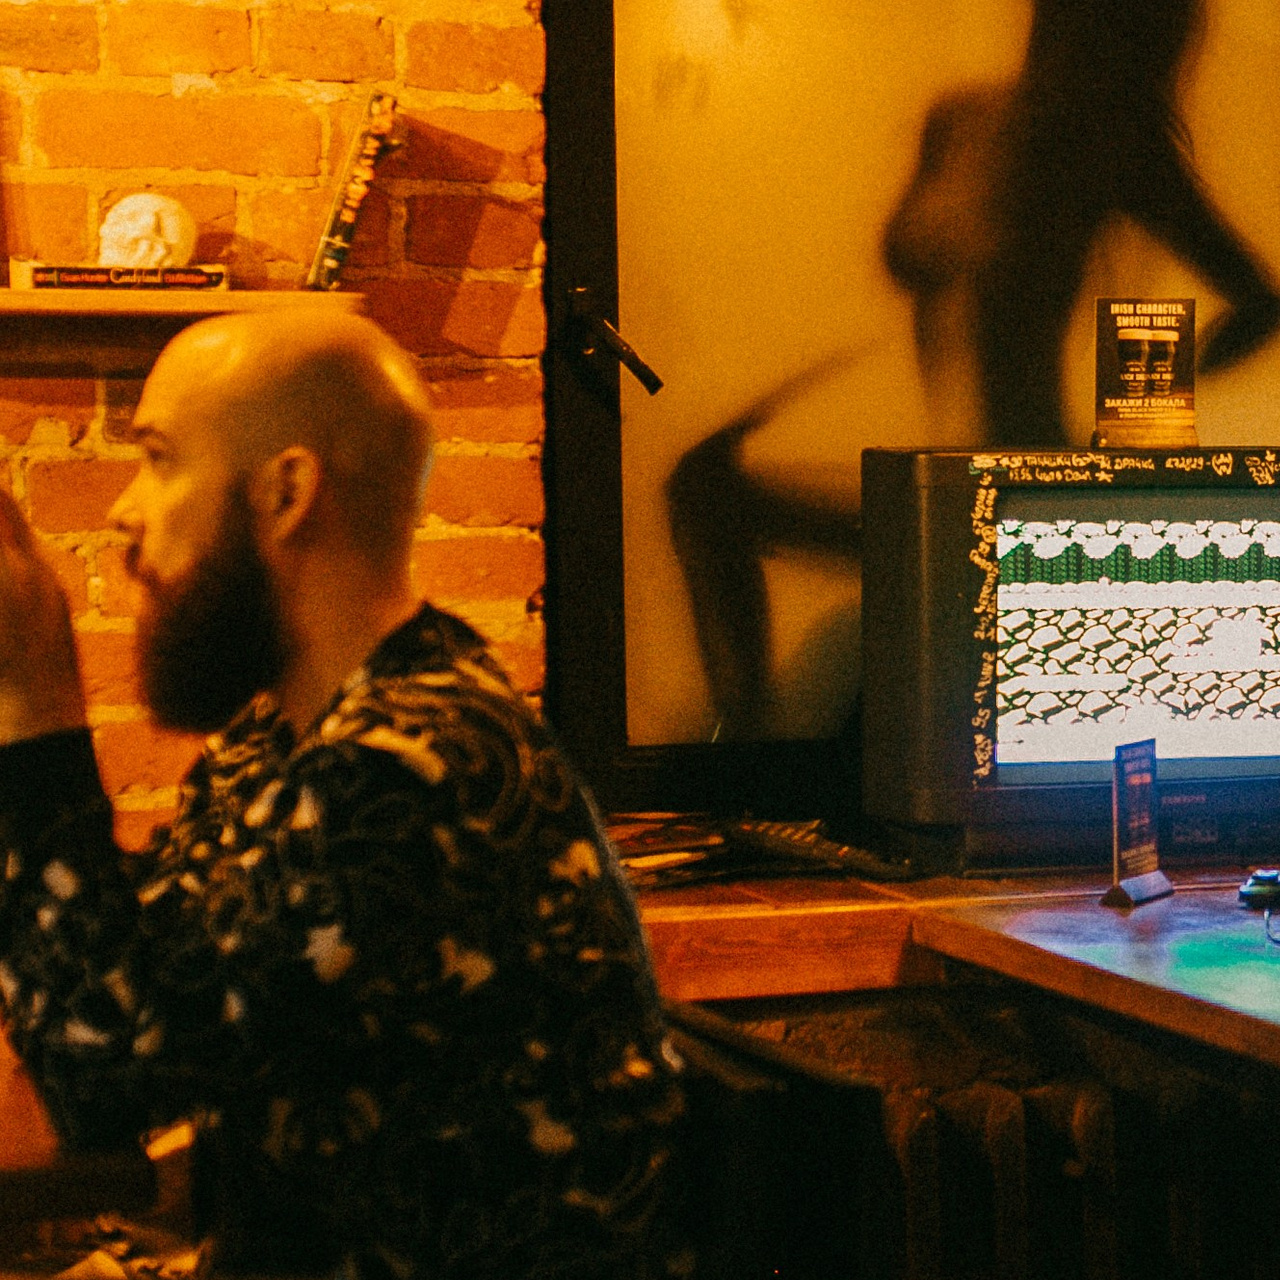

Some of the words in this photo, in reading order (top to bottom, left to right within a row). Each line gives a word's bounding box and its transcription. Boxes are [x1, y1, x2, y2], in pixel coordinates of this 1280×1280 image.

[1110, 303, 1134, 315] IRISH
[1116, 316, 1151, 327] SMOOTH
[1152, 316, 1180, 327] TASTE.
[1104, 398, 1143, 408] ЗАКАЖИ
[1143, 398, 1150, 408] 2
[1151, 398, 1186, 408] БОКАЛА
